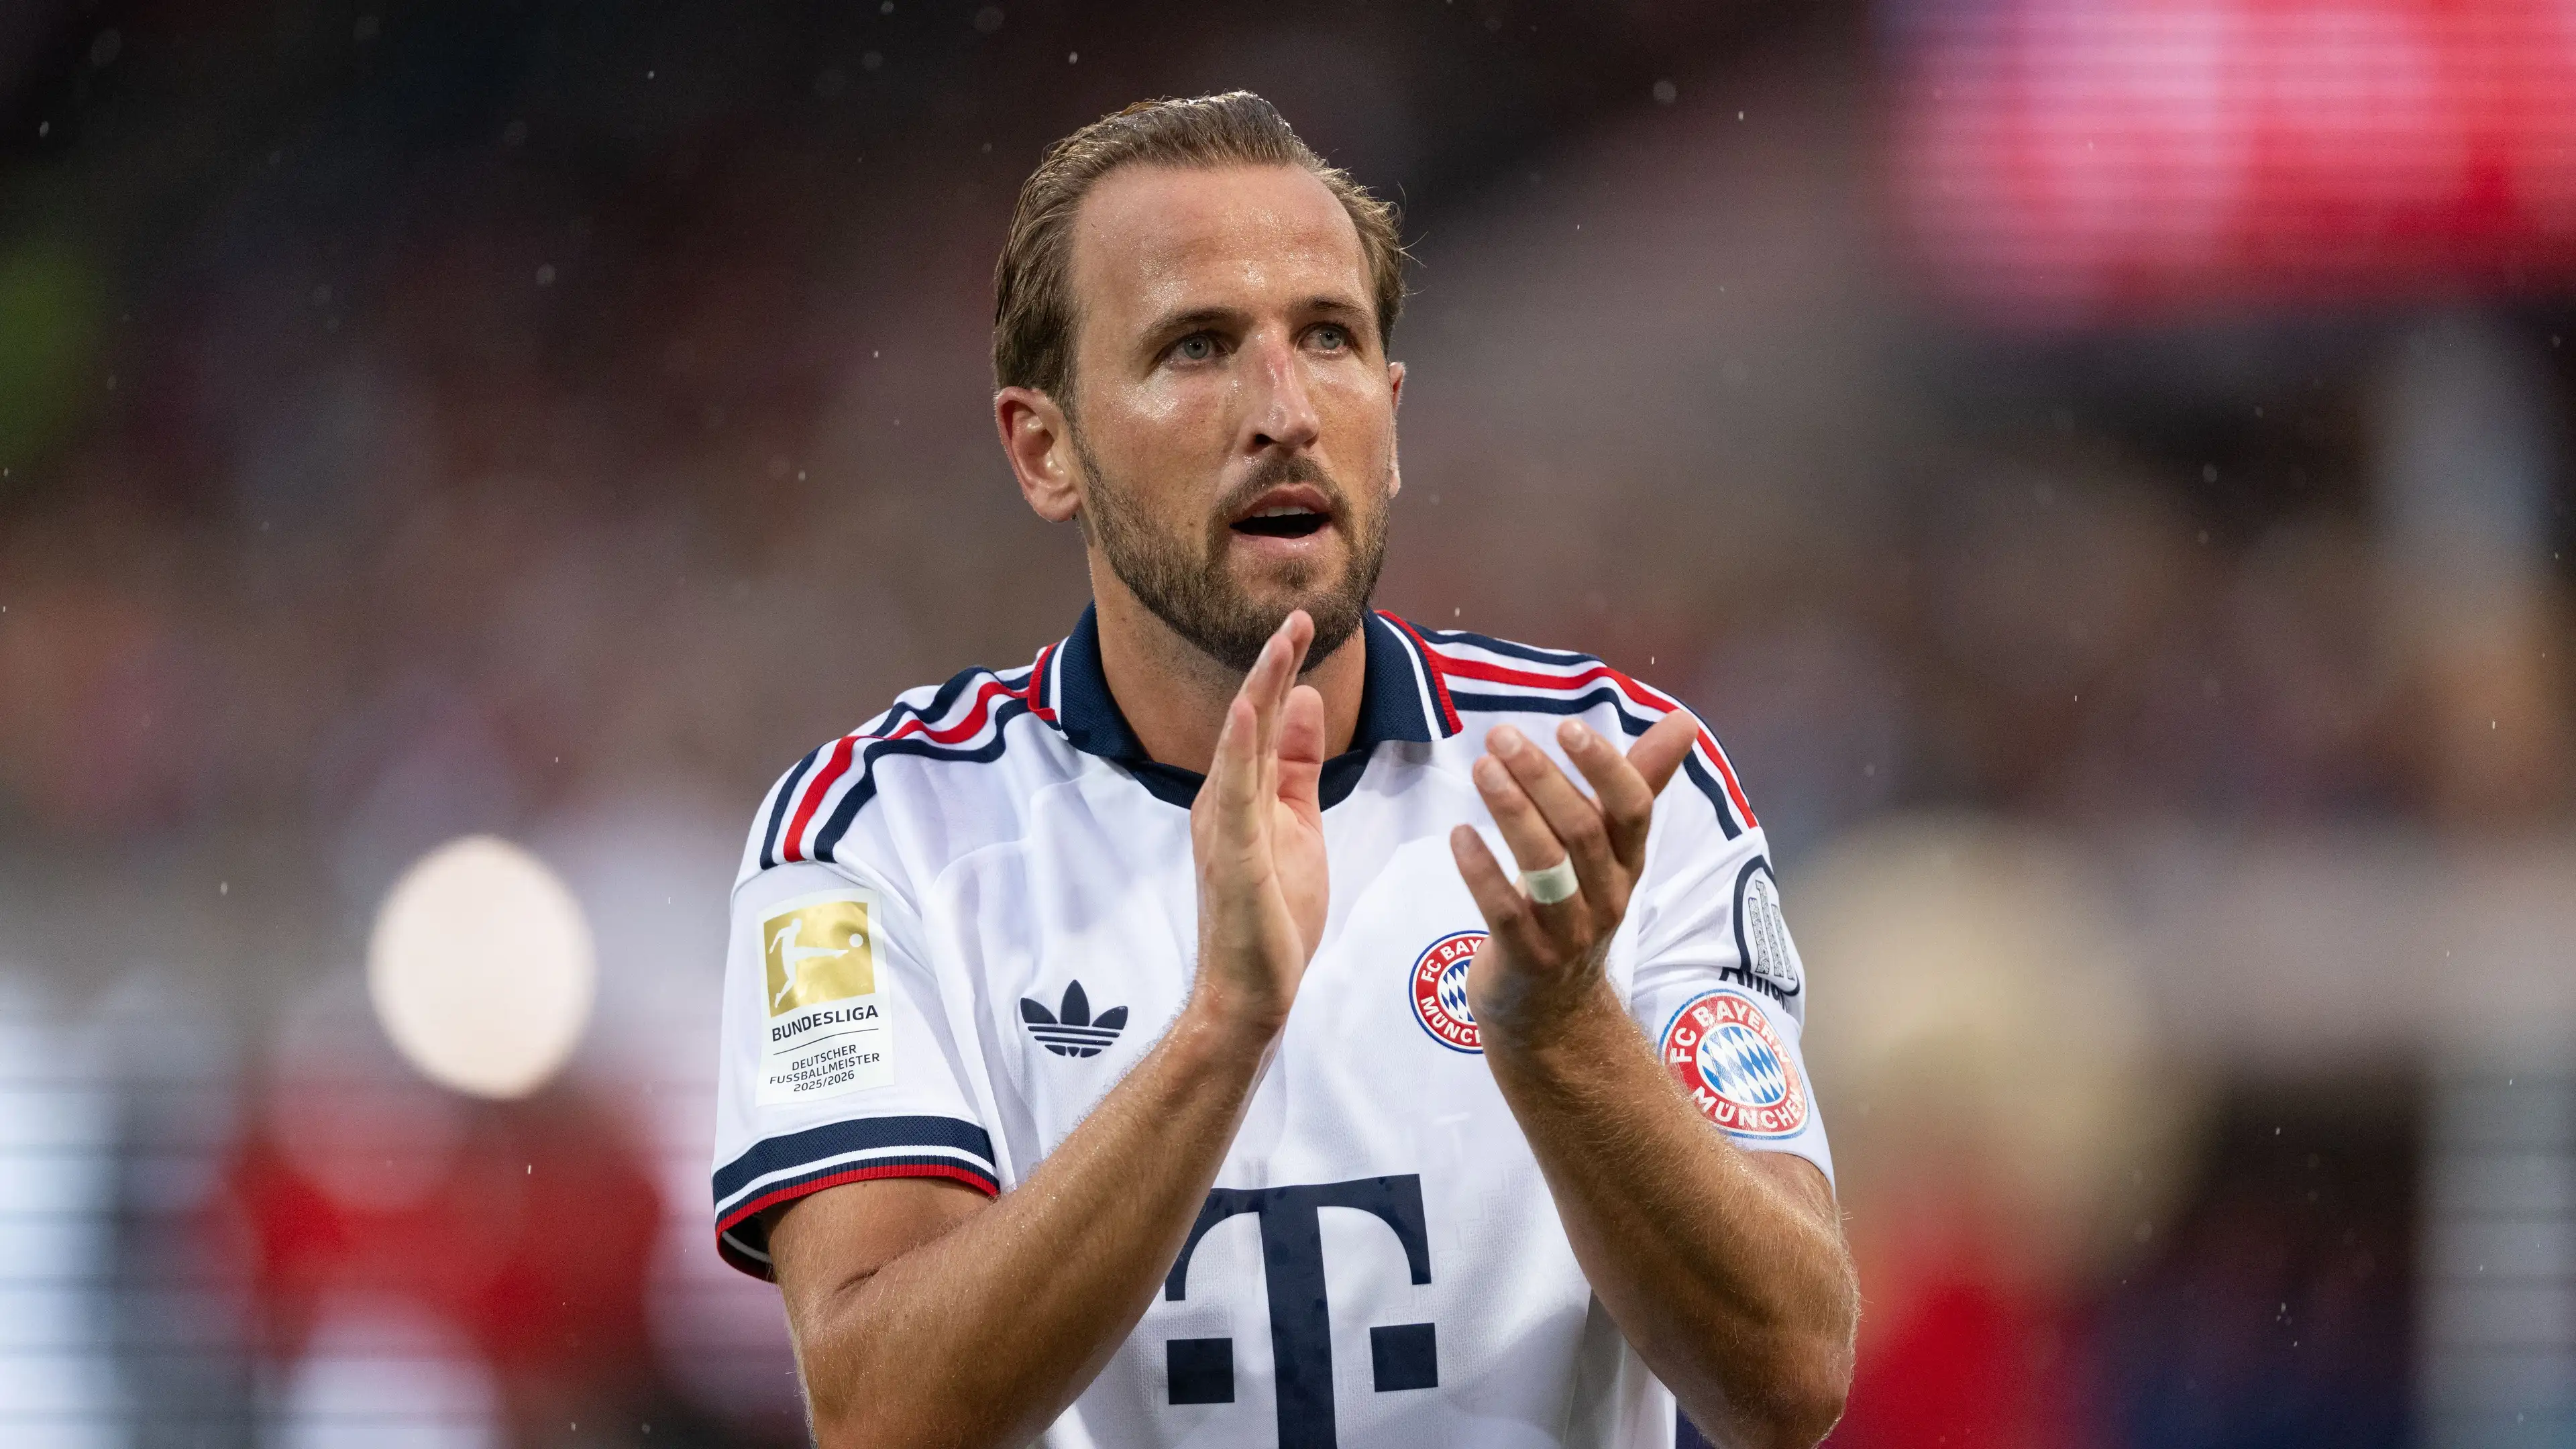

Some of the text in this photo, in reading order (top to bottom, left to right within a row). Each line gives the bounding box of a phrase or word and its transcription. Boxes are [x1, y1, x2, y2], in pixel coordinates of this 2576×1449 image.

[1421, 939, 1482, 983] FC BAY
[772, 1005, 879, 1042] BUNDESLIGA
[1420, 996, 1481, 1043] MÜNC
[1670, 1000, 1790, 1063] FC BAYERN
[769, 1053, 880, 1084] FUSSBALLMEISTER
[792, 1044, 857, 1071] DEUTSCHER
[794, 1070, 855, 1092] 2025/2026
[1690, 1085, 1803, 1128] MÜNCHEN
[1165, 1173, 1432, 1449] T
